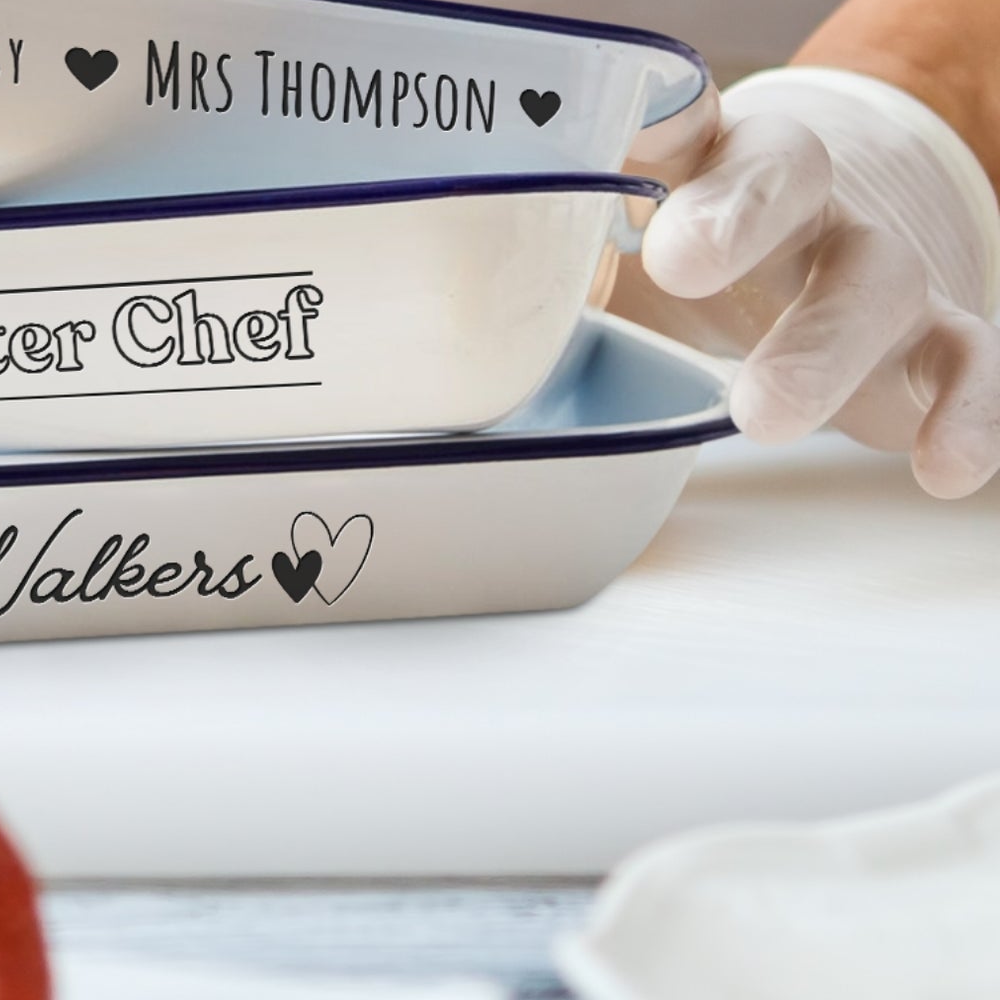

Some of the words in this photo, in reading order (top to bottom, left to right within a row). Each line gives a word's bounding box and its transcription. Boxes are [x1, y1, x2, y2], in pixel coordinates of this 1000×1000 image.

[145, 39, 233, 113] MRS
[253, 49, 496, 134] THOMPSON
[111, 284, 324, 369] Chef
